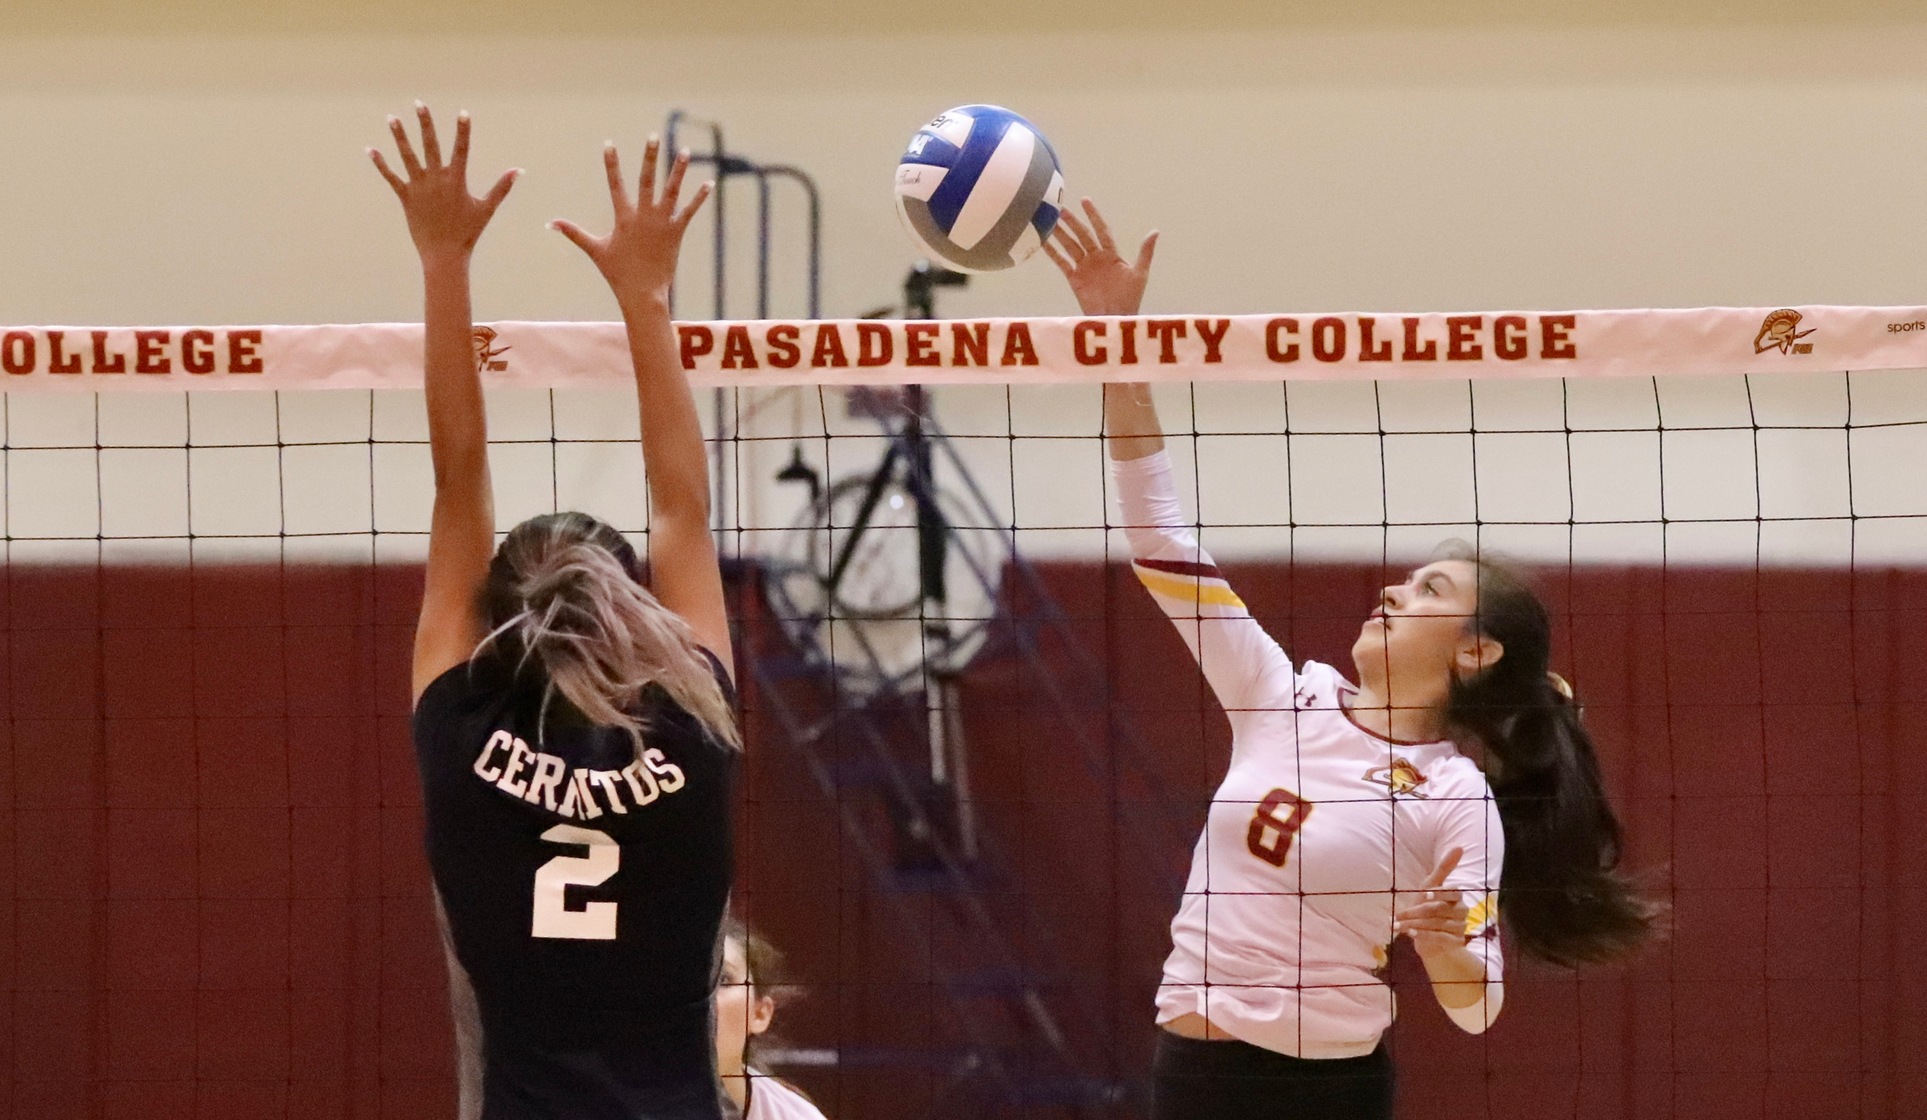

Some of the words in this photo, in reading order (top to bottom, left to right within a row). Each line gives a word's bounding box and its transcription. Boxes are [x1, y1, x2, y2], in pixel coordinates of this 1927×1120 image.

[1, 330, 263, 375] OLLEGE
[677, 322, 1040, 370] PASADENA
[1073, 318, 1230, 366] CITY
[1265, 314, 1577, 363] COLLEGE
[1887, 320, 1926, 334] sports
[1246, 786, 1314, 869] 8
[531, 823, 621, 940] 2
